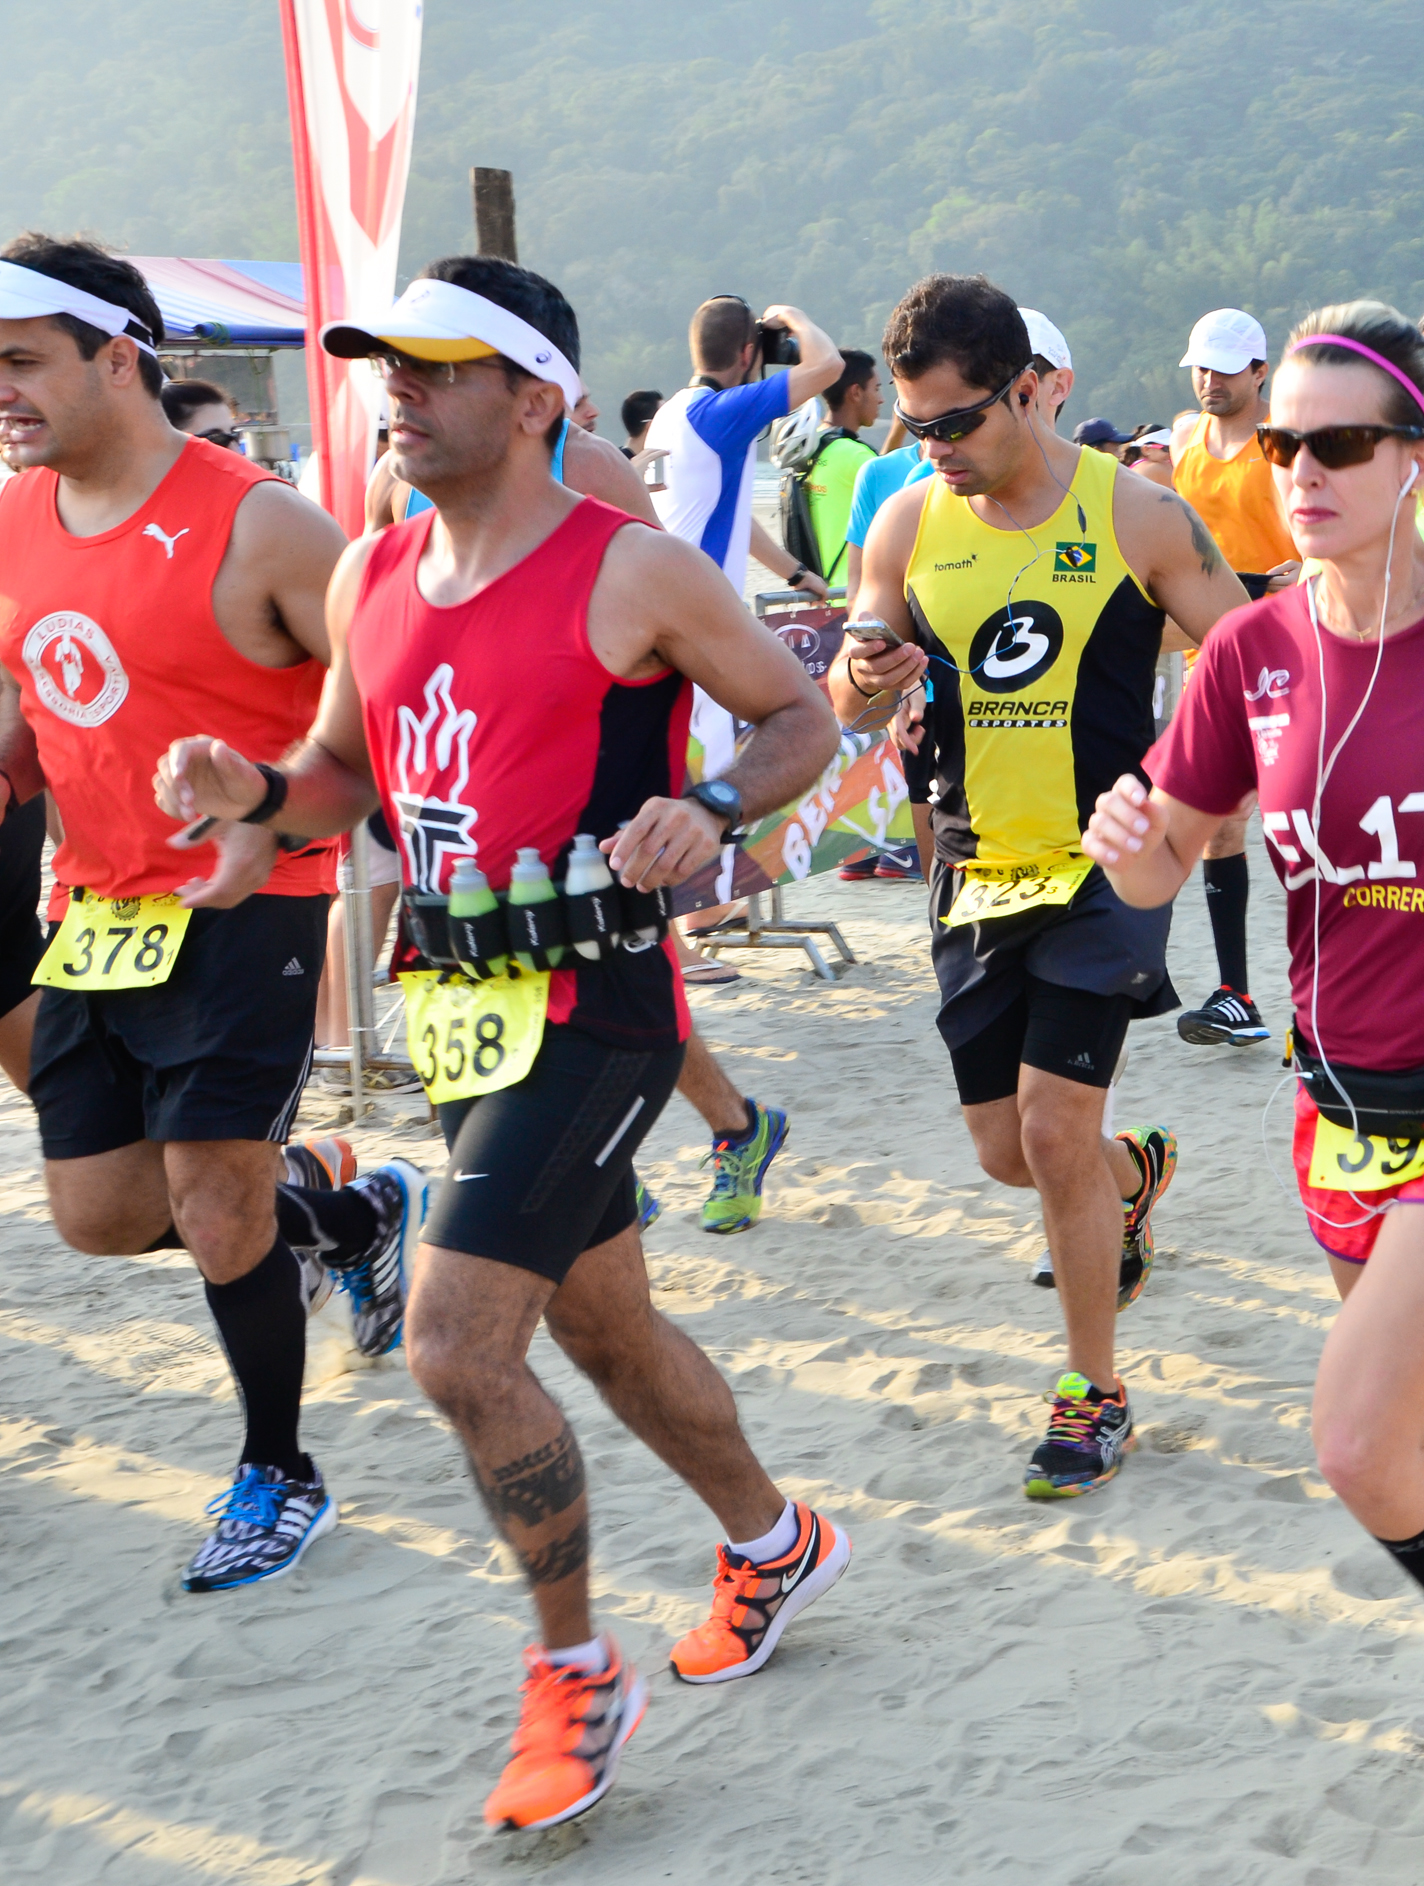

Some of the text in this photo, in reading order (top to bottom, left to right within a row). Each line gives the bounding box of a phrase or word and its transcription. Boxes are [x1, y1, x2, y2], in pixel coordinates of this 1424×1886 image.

[934, 558, 974, 573] tomath
[1052, 573, 1096, 584] BRASIL
[36, 618, 95, 640] LUDIAS
[967, 700, 1068, 716] BRANCA
[970, 719, 1067, 728] ESPORTES
[961, 876, 1053, 917] 323
[63, 924, 169, 977] 378
[422, 1013, 505, 1088] 358
